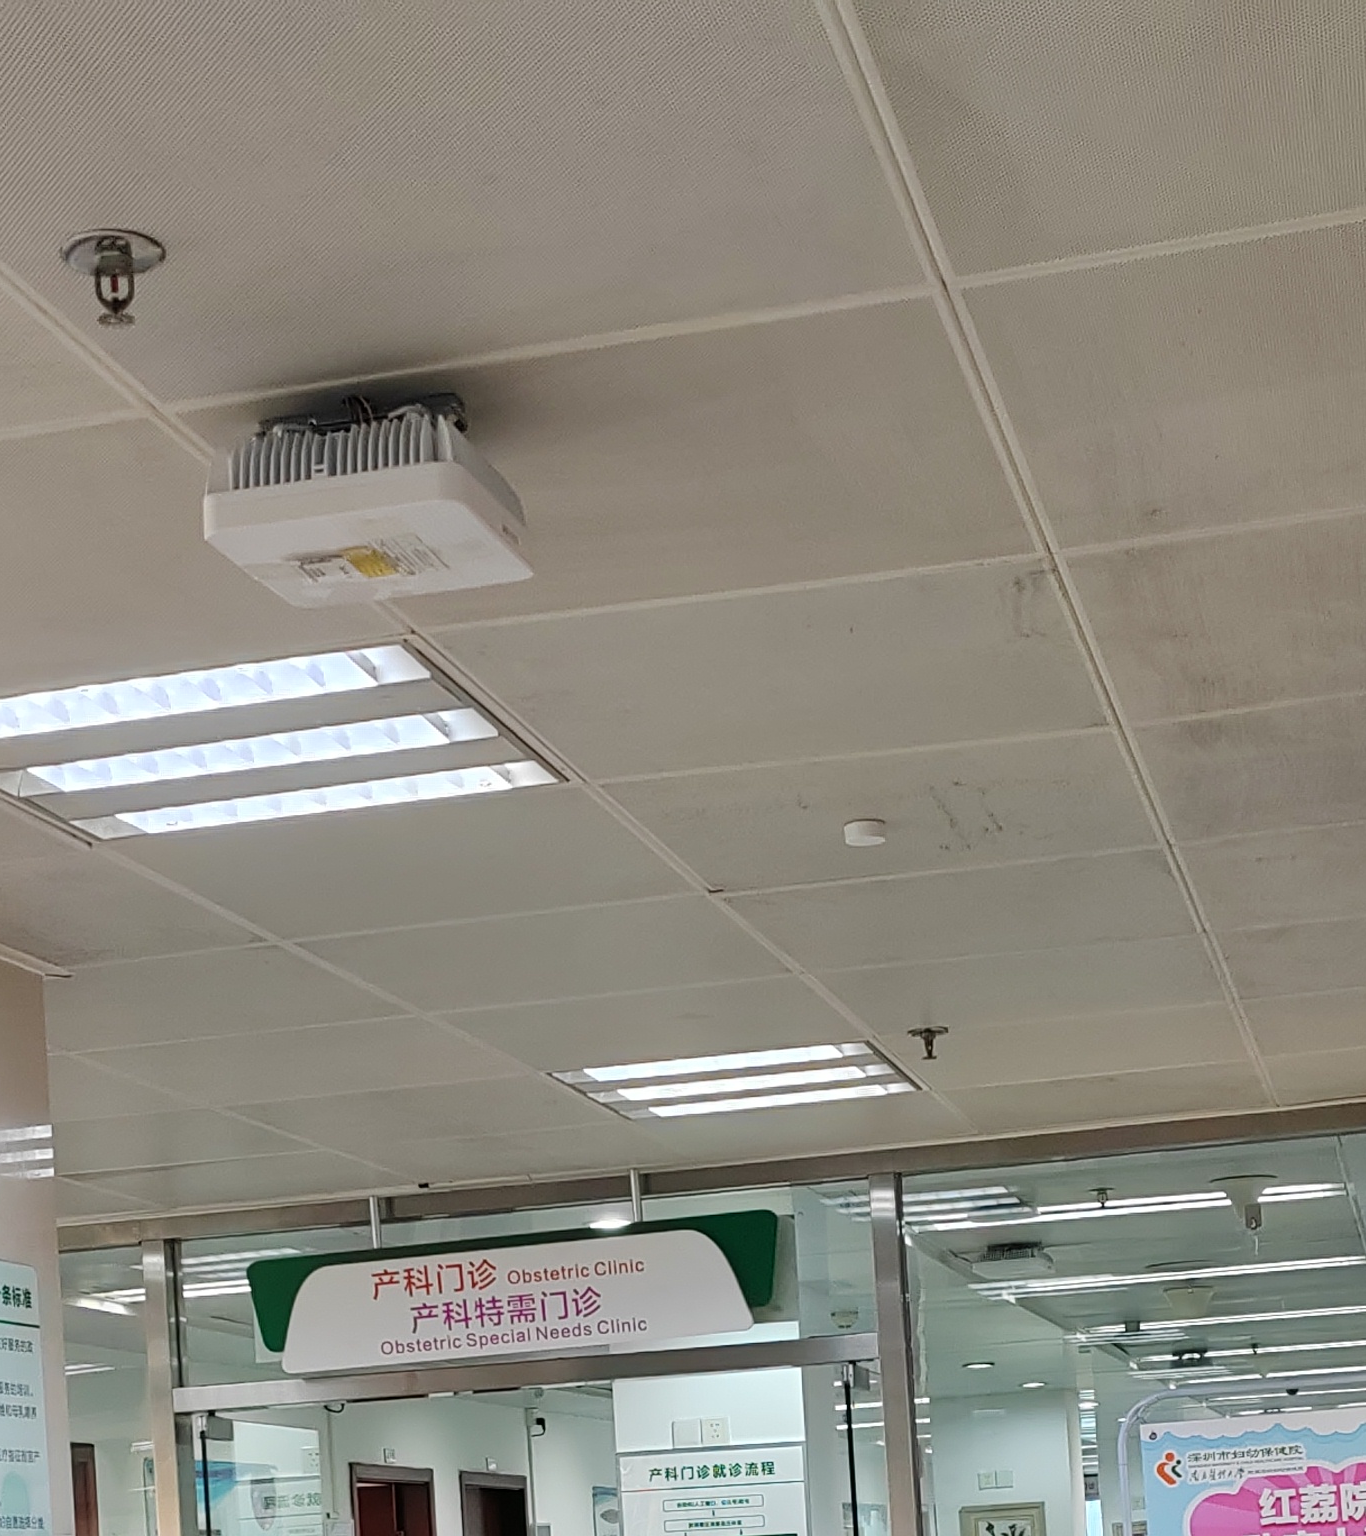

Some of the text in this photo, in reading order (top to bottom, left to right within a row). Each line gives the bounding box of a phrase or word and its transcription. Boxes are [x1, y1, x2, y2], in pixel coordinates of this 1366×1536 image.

[371, 1258, 498, 1301] 产科门诊
[506, 1257, 646, 1286] Obstetric Clinic
[409, 1286, 602, 1335] 产科特需门诊
[380, 1316, 648, 1356] Obstetric Special Needs Clinic
[1187, 1444, 1304, 1463] 深圳市妇幼保健院
[648, 1461, 776, 1483] 产科门诊就诊流程
